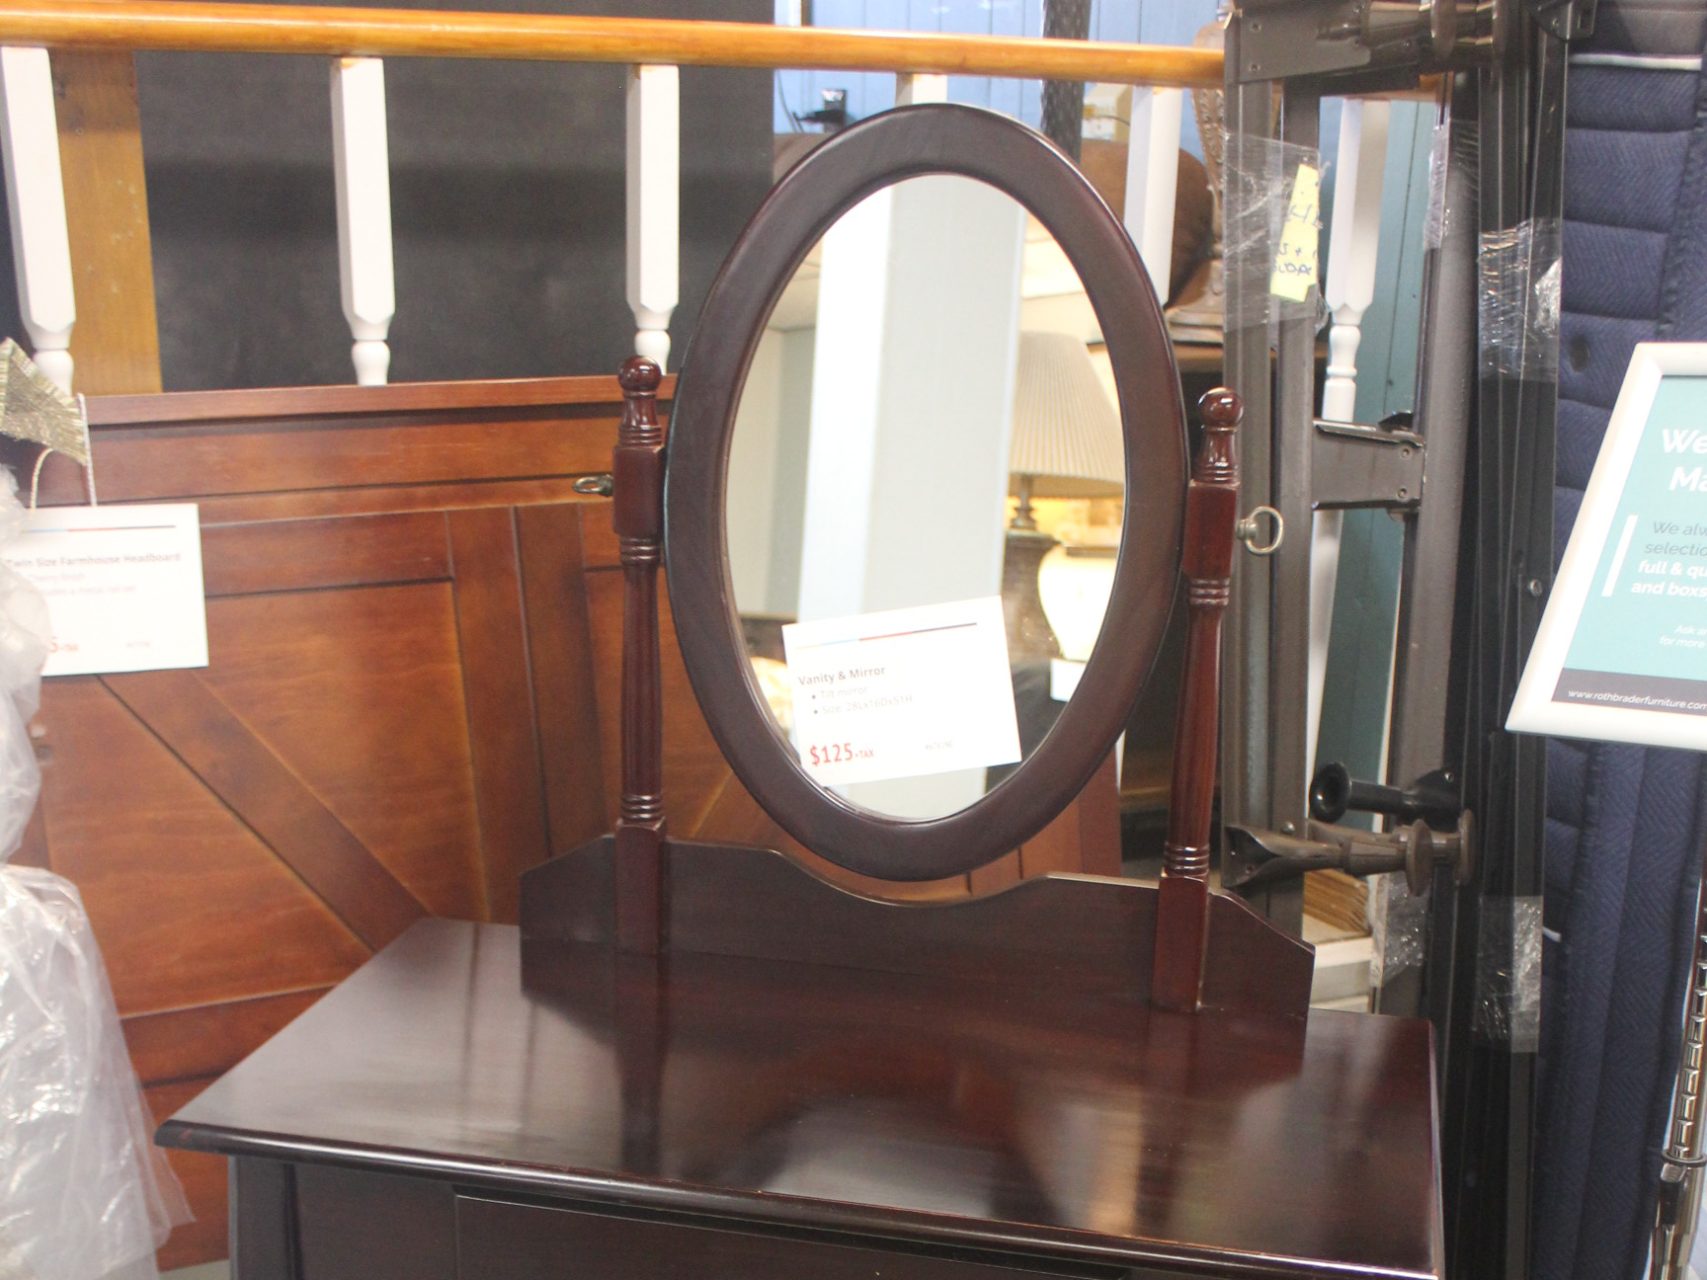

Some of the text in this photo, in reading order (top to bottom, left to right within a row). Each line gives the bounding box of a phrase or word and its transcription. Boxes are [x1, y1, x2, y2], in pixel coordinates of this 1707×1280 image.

[1653, 521, 1679, 535] We
[1638, 559, 1668, 575] full
[1670, 561, 1682, 575] &
[1630, 582, 1666, 596] and
[798, 666, 886, 686] Vanity & Mirror
[809, 742, 854, 767] $125
